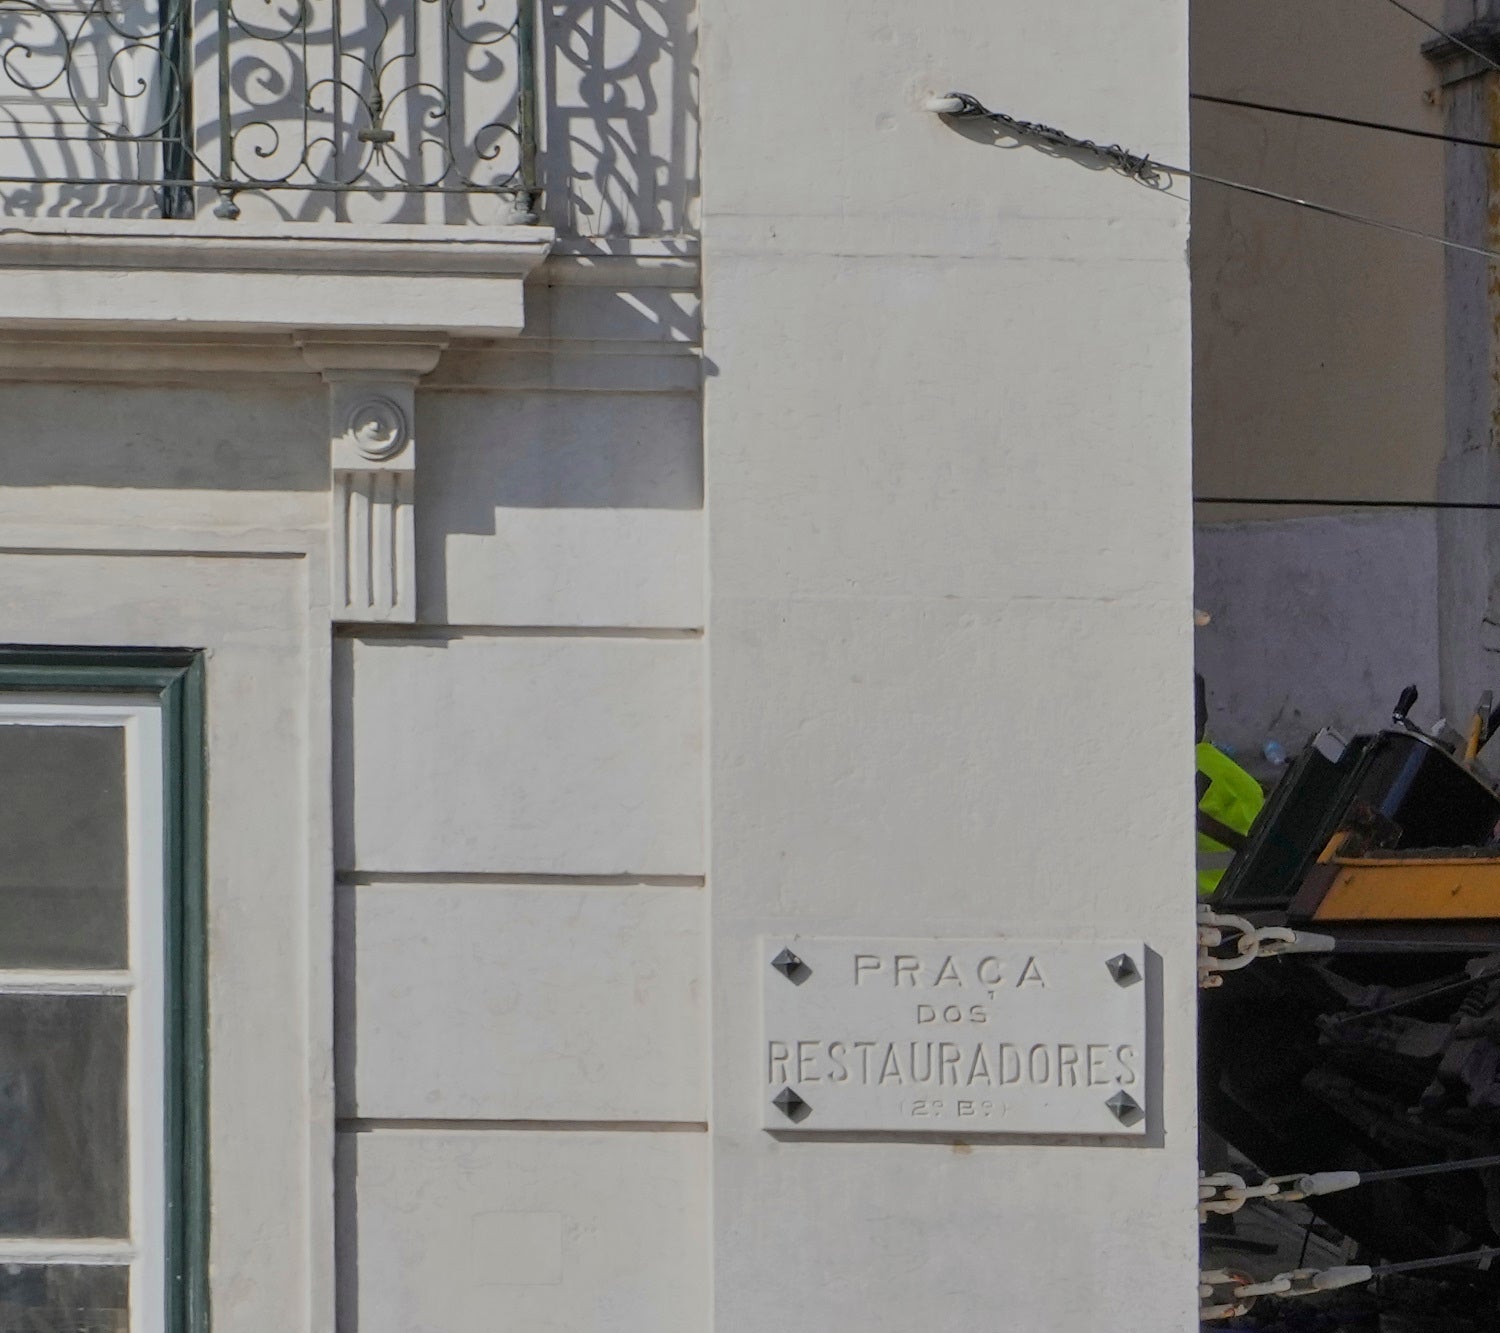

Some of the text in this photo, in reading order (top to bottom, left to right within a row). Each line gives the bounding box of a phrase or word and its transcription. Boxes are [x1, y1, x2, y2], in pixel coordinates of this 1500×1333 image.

[853, 954, 1048, 1000] PRAÇA
[916, 1003, 988, 1025] DOS
[767, 1040, 1138, 1088] RESTAURADORES
